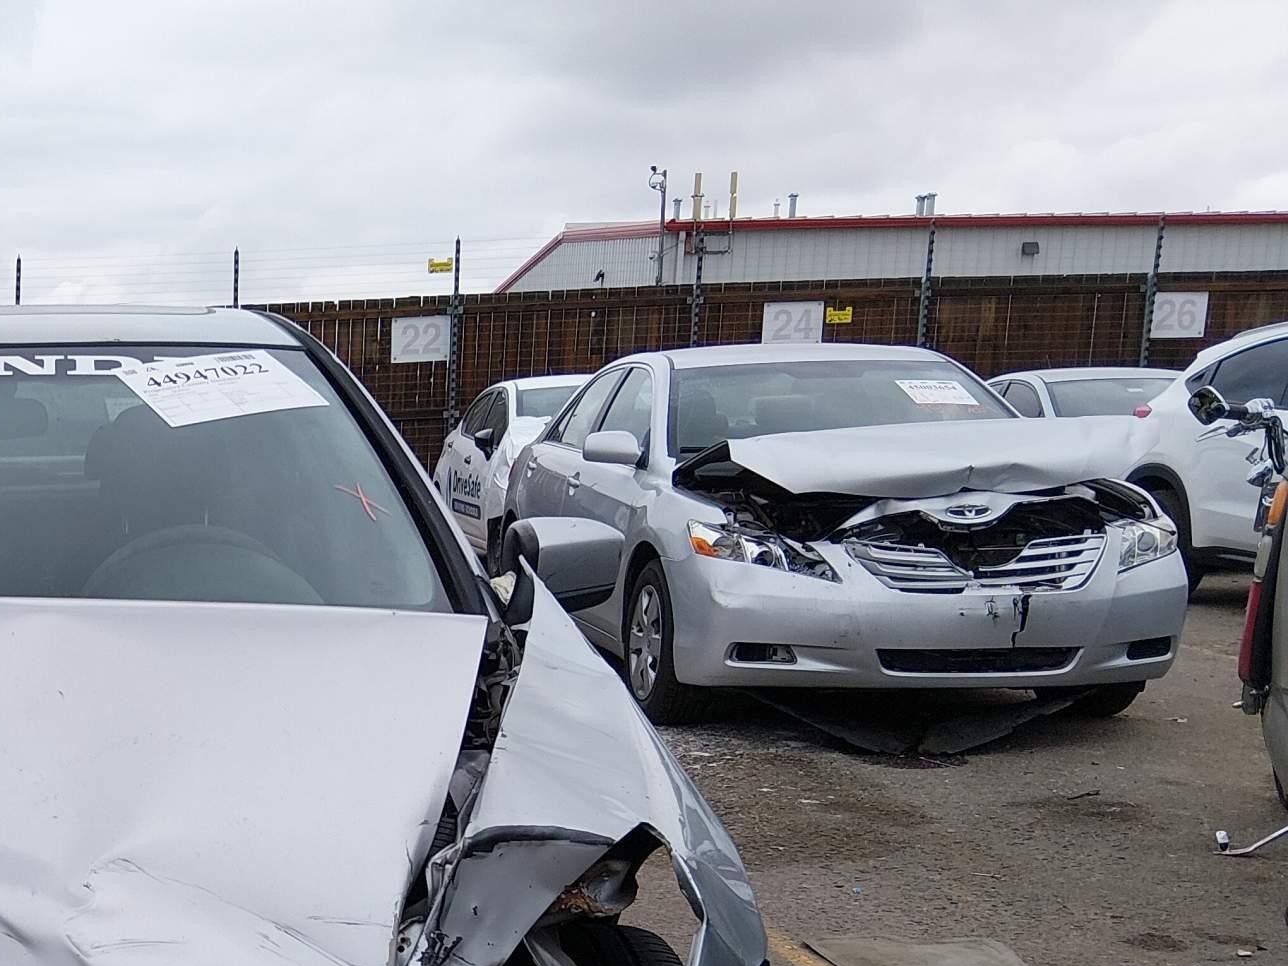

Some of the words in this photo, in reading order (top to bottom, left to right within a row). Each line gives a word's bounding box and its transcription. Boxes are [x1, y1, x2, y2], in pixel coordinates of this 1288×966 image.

[772, 308, 814, 340] 24
[1155, 299, 1197, 330] 26
[400, 322, 441, 355] 22
[146, 363, 270, 388] 44947022
[452, 469, 481, 499] DriveSafe
